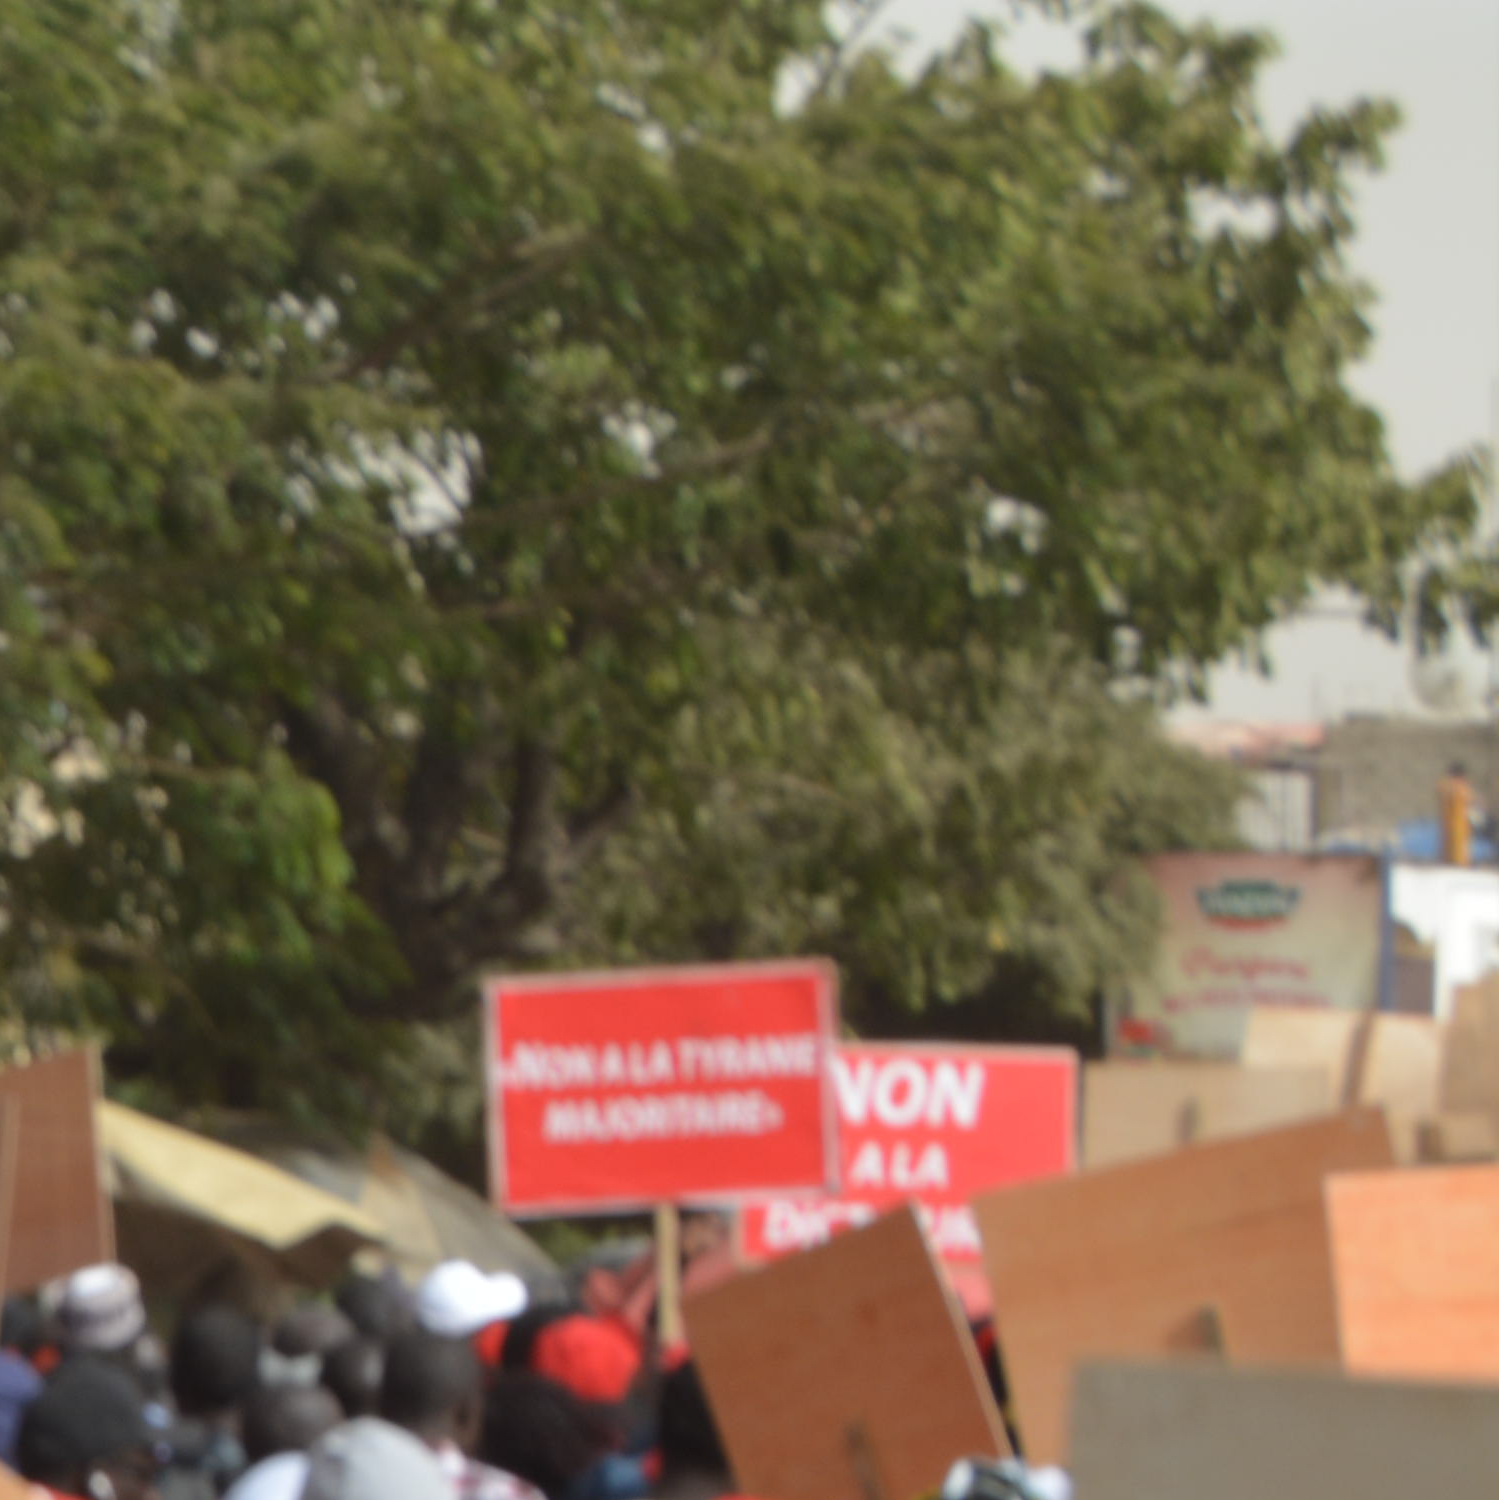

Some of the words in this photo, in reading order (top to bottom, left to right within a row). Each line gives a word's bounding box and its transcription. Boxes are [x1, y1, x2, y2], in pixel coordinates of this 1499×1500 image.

[603, 1042, 623, 1083] A
[630, 1041, 672, 1082] LA
[851, 1140, 883, 1188] A
[890, 1142, 948, 1189] LA
